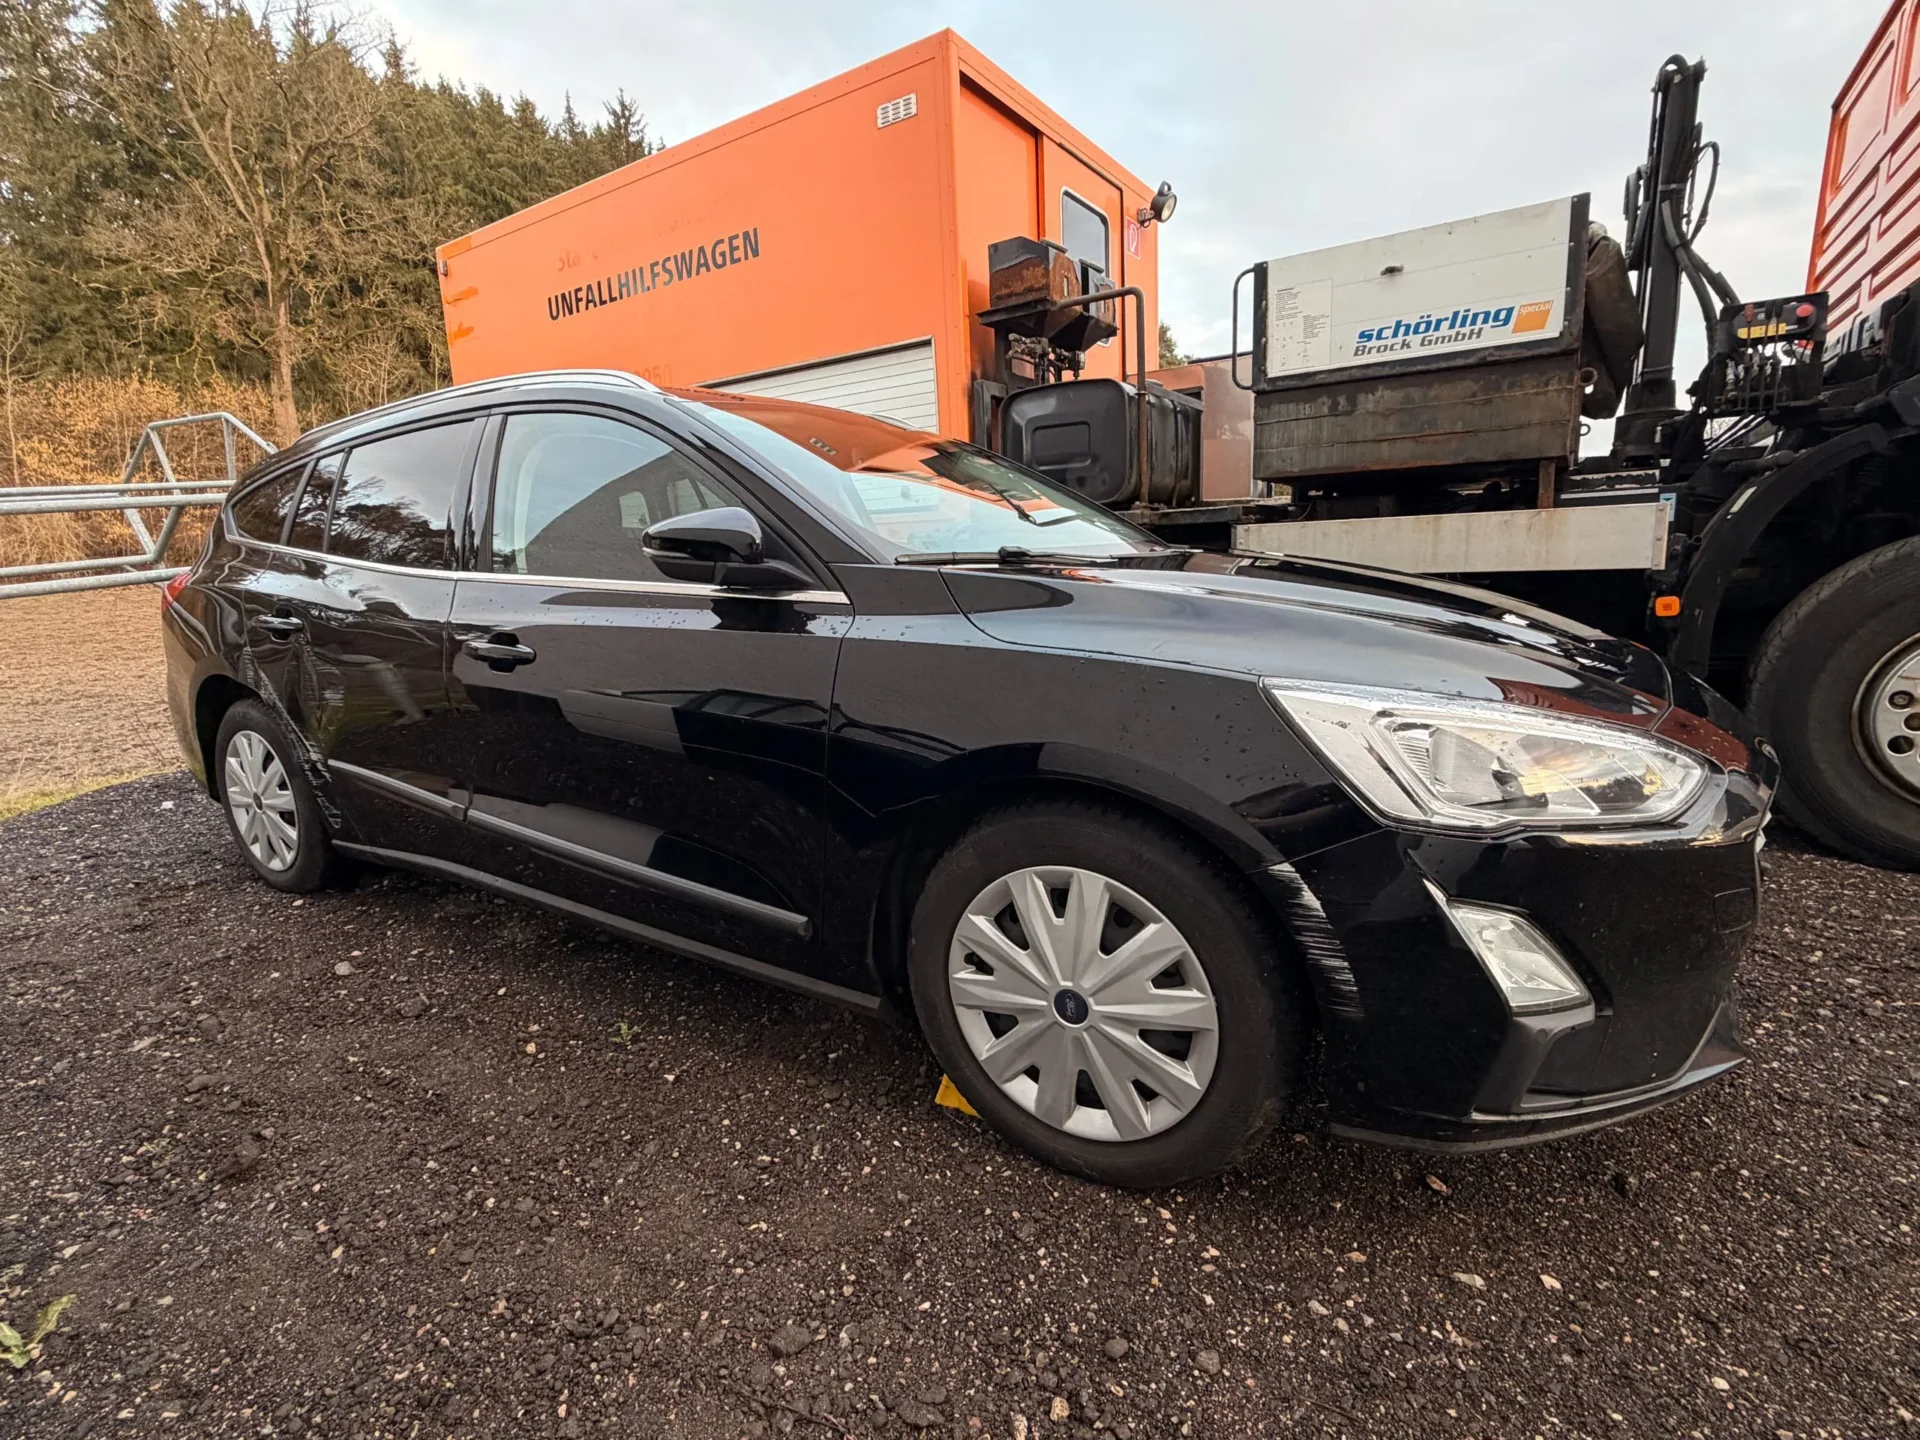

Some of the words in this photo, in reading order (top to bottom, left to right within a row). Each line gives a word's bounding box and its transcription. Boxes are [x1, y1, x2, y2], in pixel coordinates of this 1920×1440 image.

[547, 227, 760, 321] UNFALLHILFSWAGEN
[1356, 305, 1516, 344] schörling
[1519, 302, 1552, 315] special
[1353, 338, 1412, 357] Brock
[1419, 327, 1484, 348] GmbH
